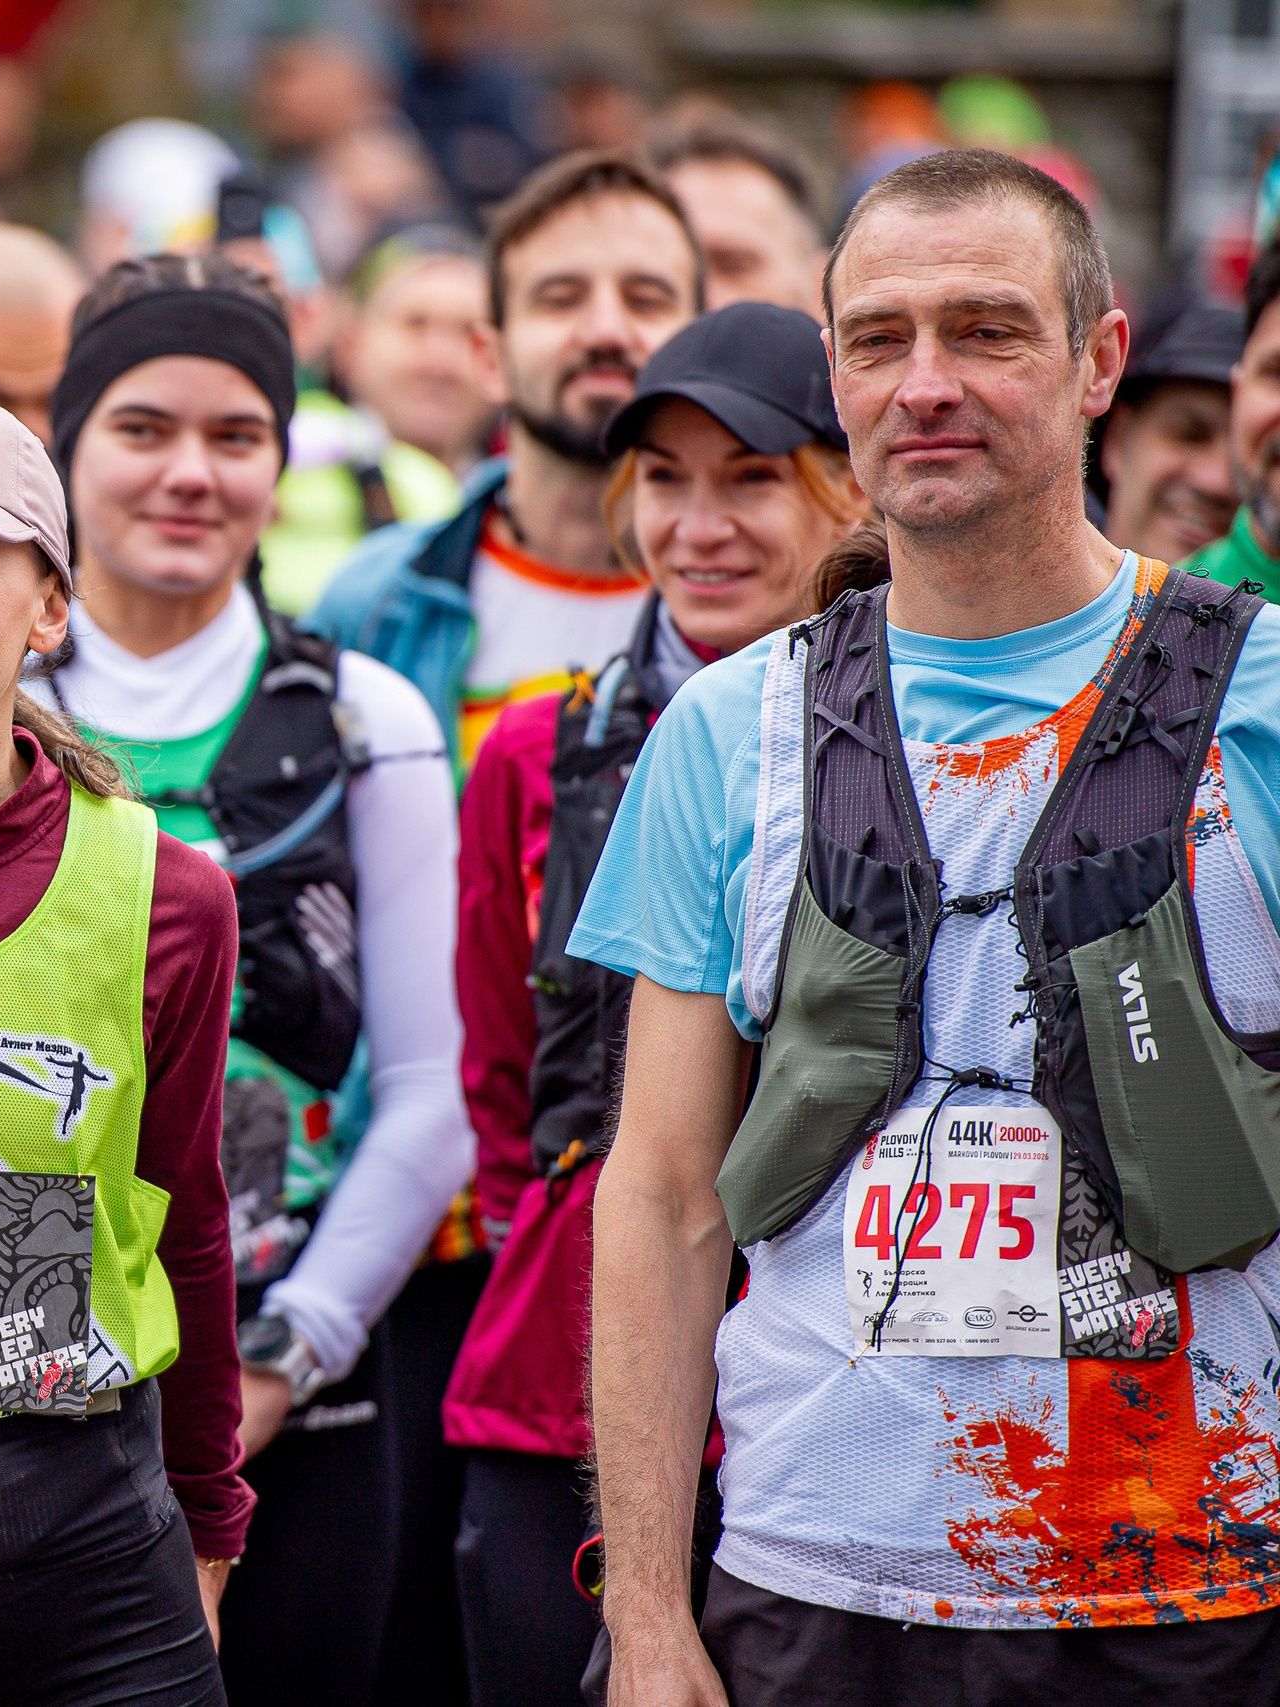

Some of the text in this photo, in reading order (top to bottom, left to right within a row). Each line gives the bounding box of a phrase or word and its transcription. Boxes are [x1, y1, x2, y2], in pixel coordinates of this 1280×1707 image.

[1118, 961, 1159, 1063] SILVA
[0, 1037, 33, 1051] Атлет
[35, 1041, 73, 1056] Мездра
[880, 1133, 919, 1146] PLOVDIV
[948, 1120, 1050, 1146] 44K 2000D+
[879, 1147, 904, 1158] HILLS
[948, 1150, 979, 1159] MARKOVO
[983, 1151, 1009, 1159] PLOVDIV
[854, 1183, 1036, 1261] 4275
[882, 1279, 928, 1287] Феерация
[1057, 1250, 1132, 1293] EVERY
[1061, 1279, 1121, 1316] STEP
[1069, 1288, 1178, 1340] MATTERS
